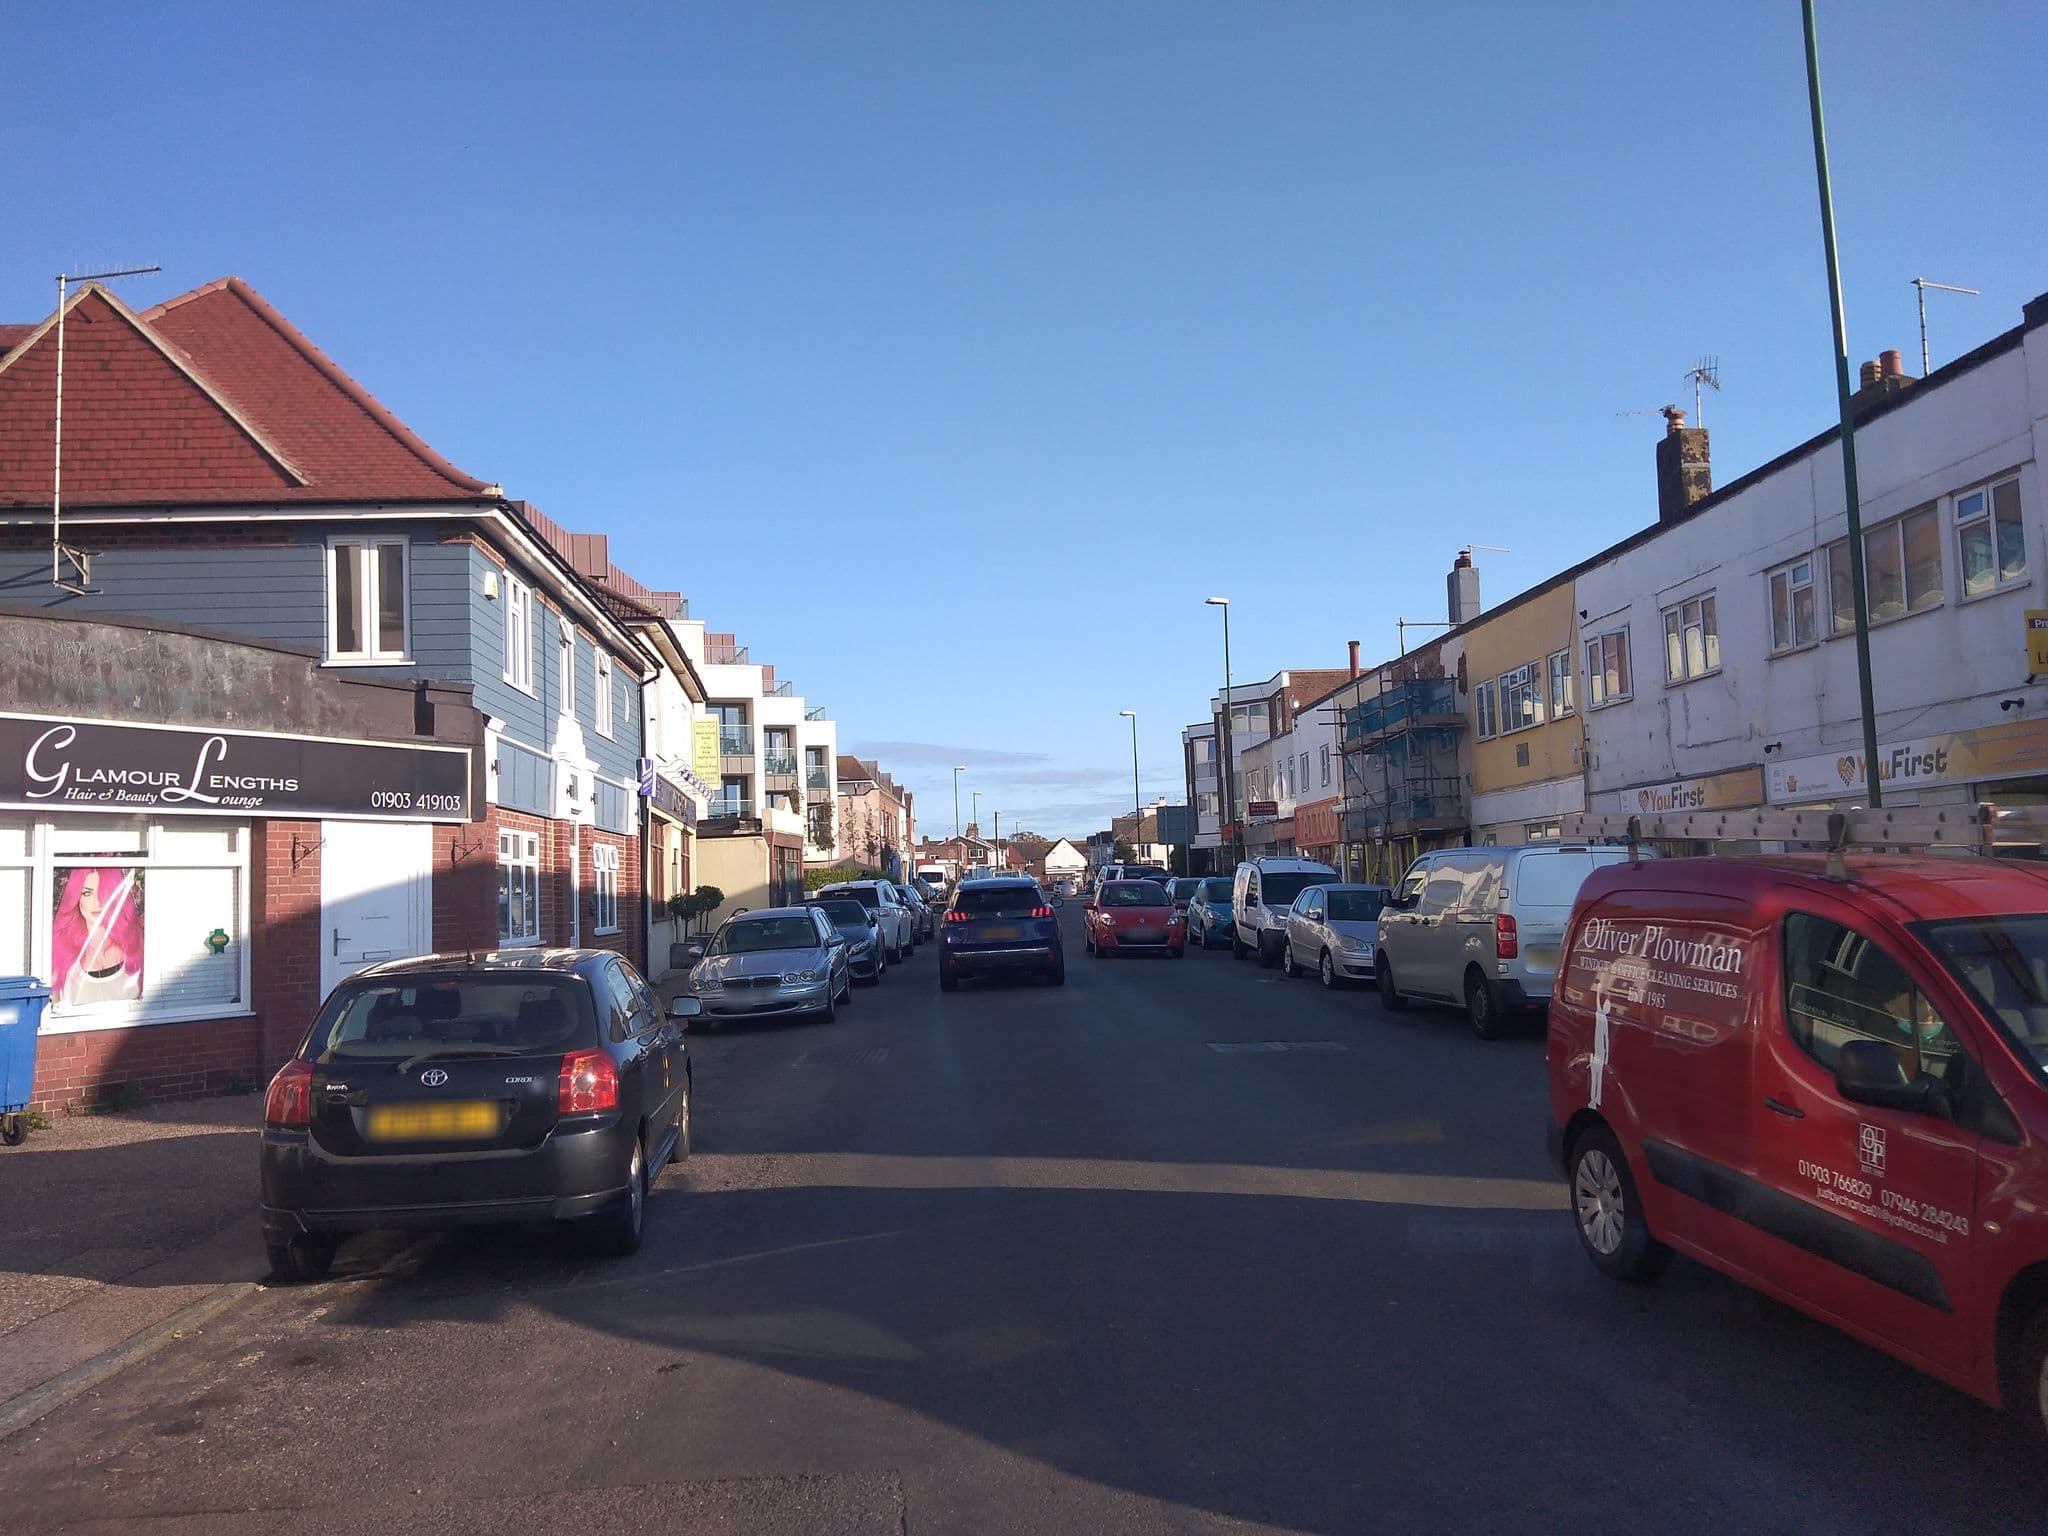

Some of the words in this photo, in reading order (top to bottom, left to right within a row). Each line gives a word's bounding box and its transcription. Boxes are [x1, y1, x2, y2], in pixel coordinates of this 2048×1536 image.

[1858, 746, 1948, 784] YuFirst
[64, 787, 97, 801] Hair
[115, 789, 158, 804] Beauty
[371, 791, 411, 809] 01903
[416, 794, 461, 811] 419103
[1650, 785, 1704, 811] YouFirst
[1584, 917, 1638, 956] Oliver
[1641, 925, 1742, 973] Plowman
[1618, 963, 1646, 980] OFFICE
[1647, 969, 1692, 988] CLEANING
[1692, 978, 1738, 999] SERVICES
[1647, 991, 1665, 1009] 1985
[1798, 1159, 1830, 1185] 01903
[1832, 1171, 1872, 1200] 766829
[1880, 1189, 1919, 1217] 07946
